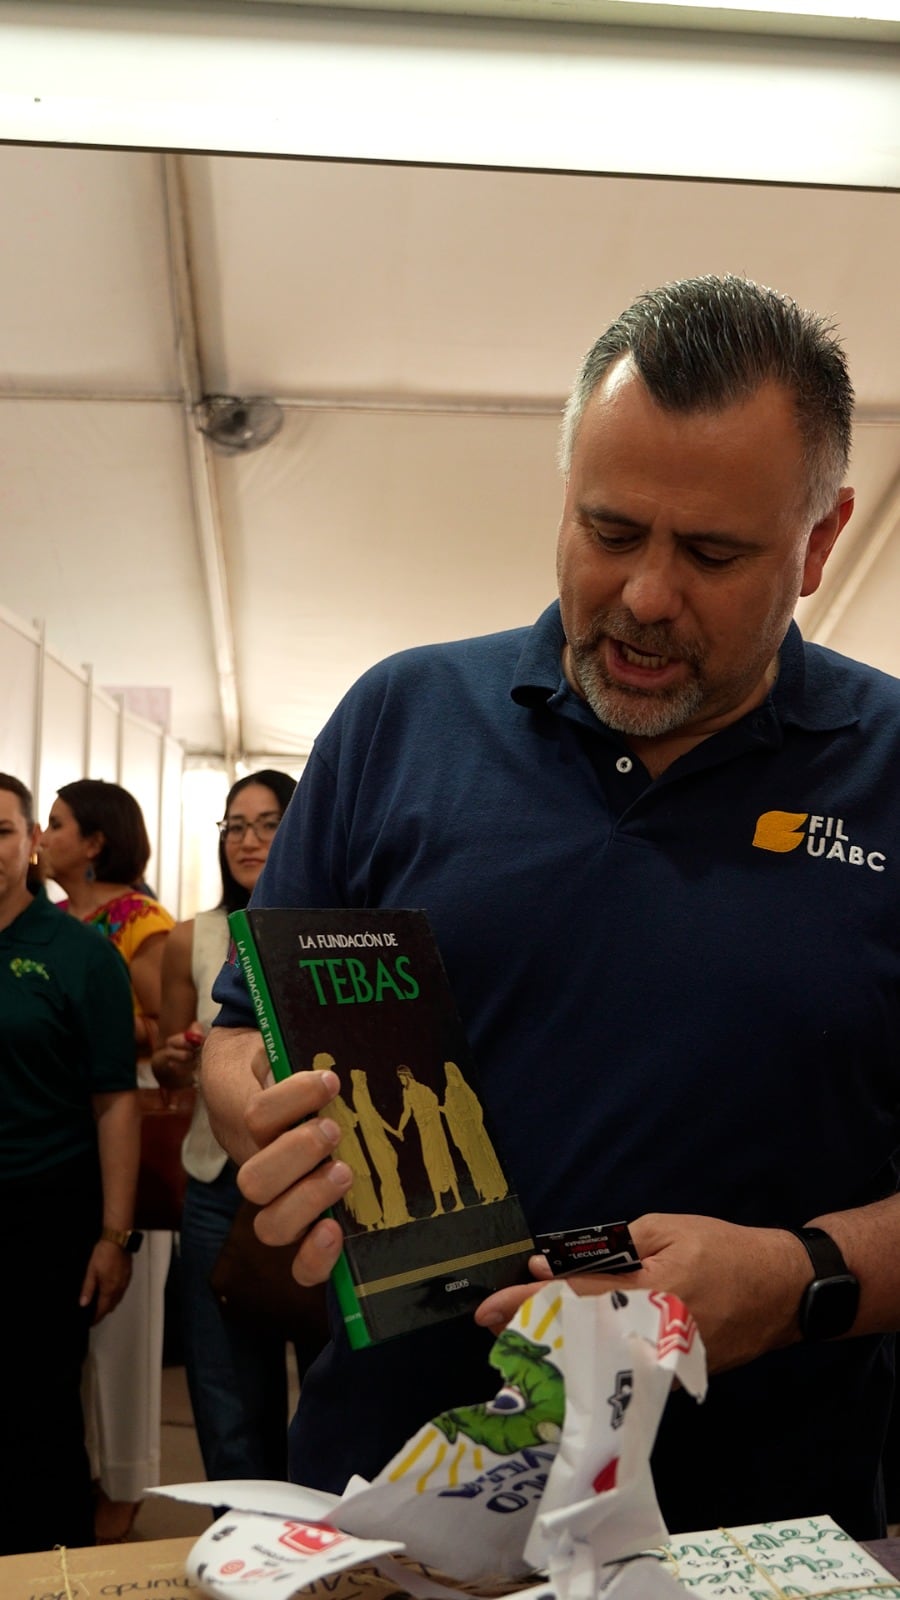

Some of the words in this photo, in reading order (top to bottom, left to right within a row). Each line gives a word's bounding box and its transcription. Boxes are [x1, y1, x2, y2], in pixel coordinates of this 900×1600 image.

[809, 815, 849, 841] FIL
[806, 835, 887, 872] UABC
[237, 940, 246, 956] LA
[298, 935, 317, 949] LA
[317, 931, 384, 949] FUNDACIÓN
[383, 933, 399, 947] DE
[241, 955, 266, 1016] FUNDACIÓN
[298, 956, 420, 1006] TEBAS
[259, 1017, 270, 1031] DE
[264, 1031, 279, 1063] TEBAS
